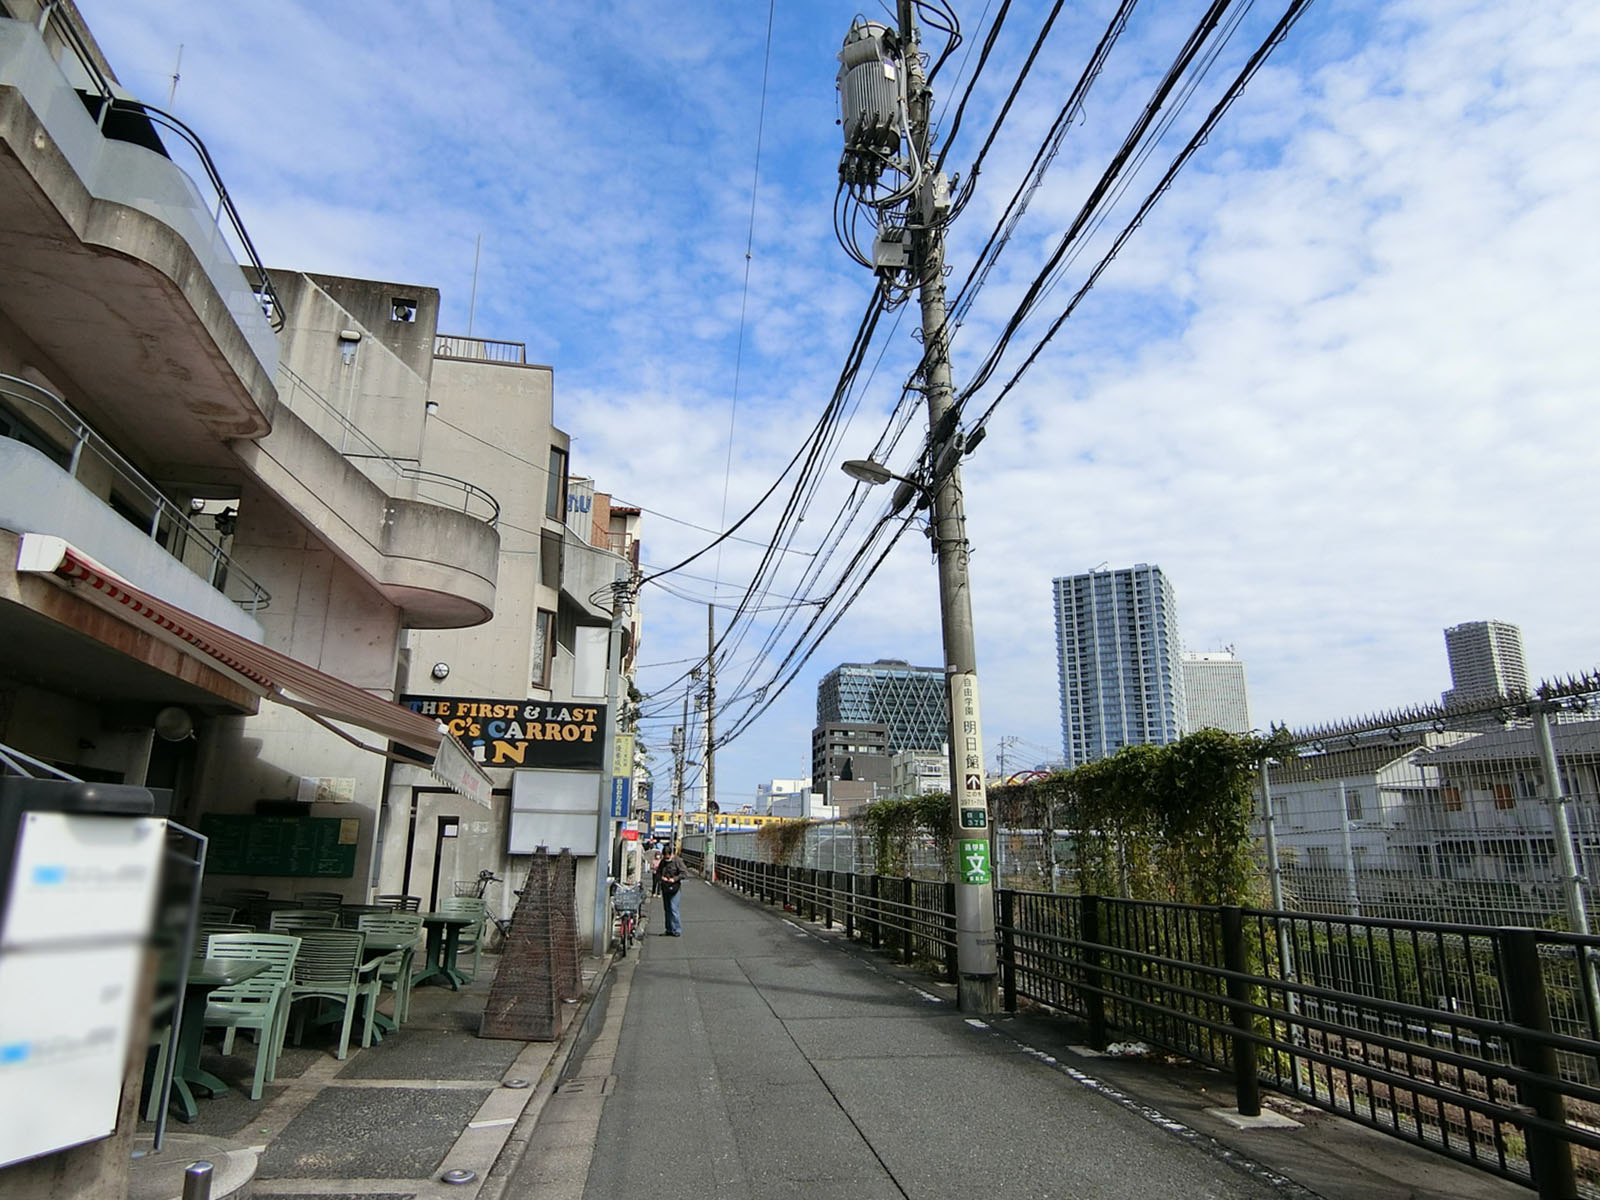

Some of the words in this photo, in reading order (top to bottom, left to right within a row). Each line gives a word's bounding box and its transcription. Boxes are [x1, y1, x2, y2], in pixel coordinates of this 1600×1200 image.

[409, 701, 450, 715] THE
[457, 702, 518, 719] FIRST
[523, 706, 540, 720] &
[546, 707, 598, 722] LAST
[487, 720, 598, 743] CARROT
[963, 720, 980, 769] 明日館
[966, 853, 986, 876] 文
